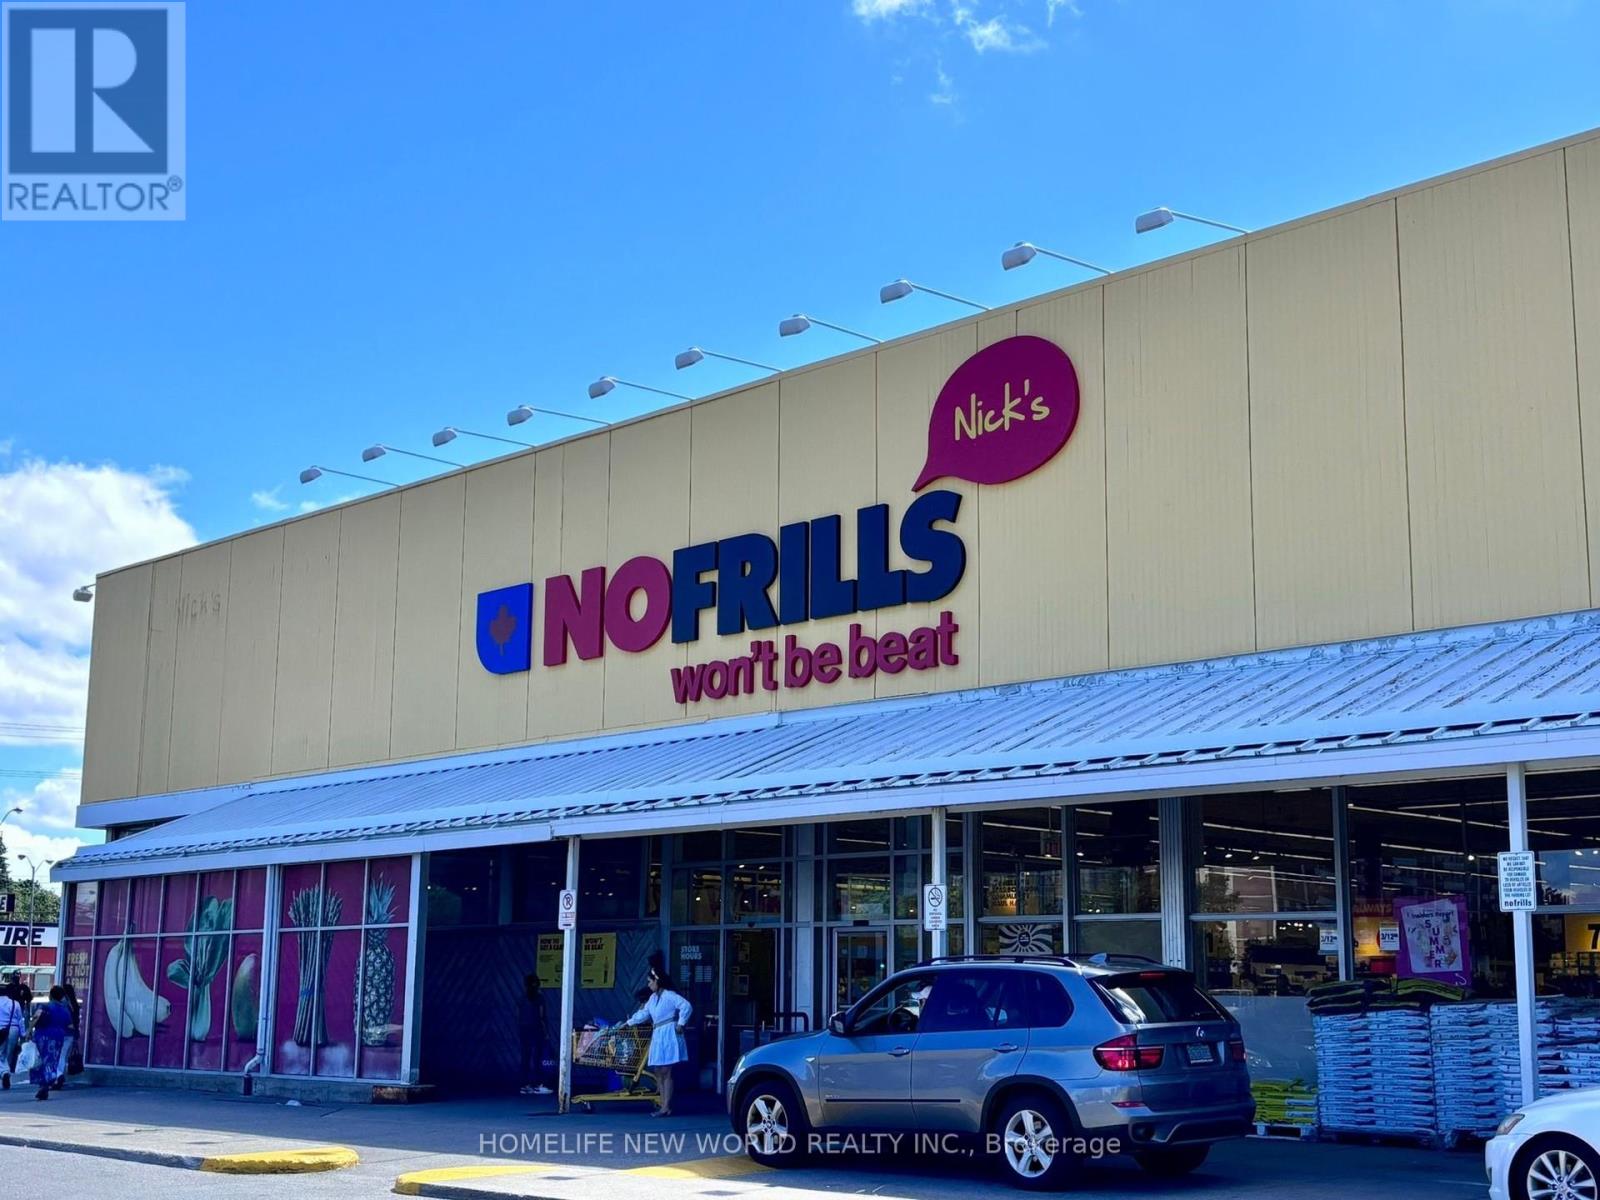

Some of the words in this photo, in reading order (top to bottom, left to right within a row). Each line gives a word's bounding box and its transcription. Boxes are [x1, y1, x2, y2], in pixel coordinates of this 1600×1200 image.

[953, 379, 1050, 440] Nick's
[671, 639, 778, 705] won't
[784, 634, 843, 688] be
[848, 611, 959, 678] beat
[1504, 899, 1532, 907] nofrills
[0, 927, 45, 946] IRE
[67, 952, 88, 964] FRESH
[66, 965, 73, 977] IS
[74, 964, 90, 977] NOT
